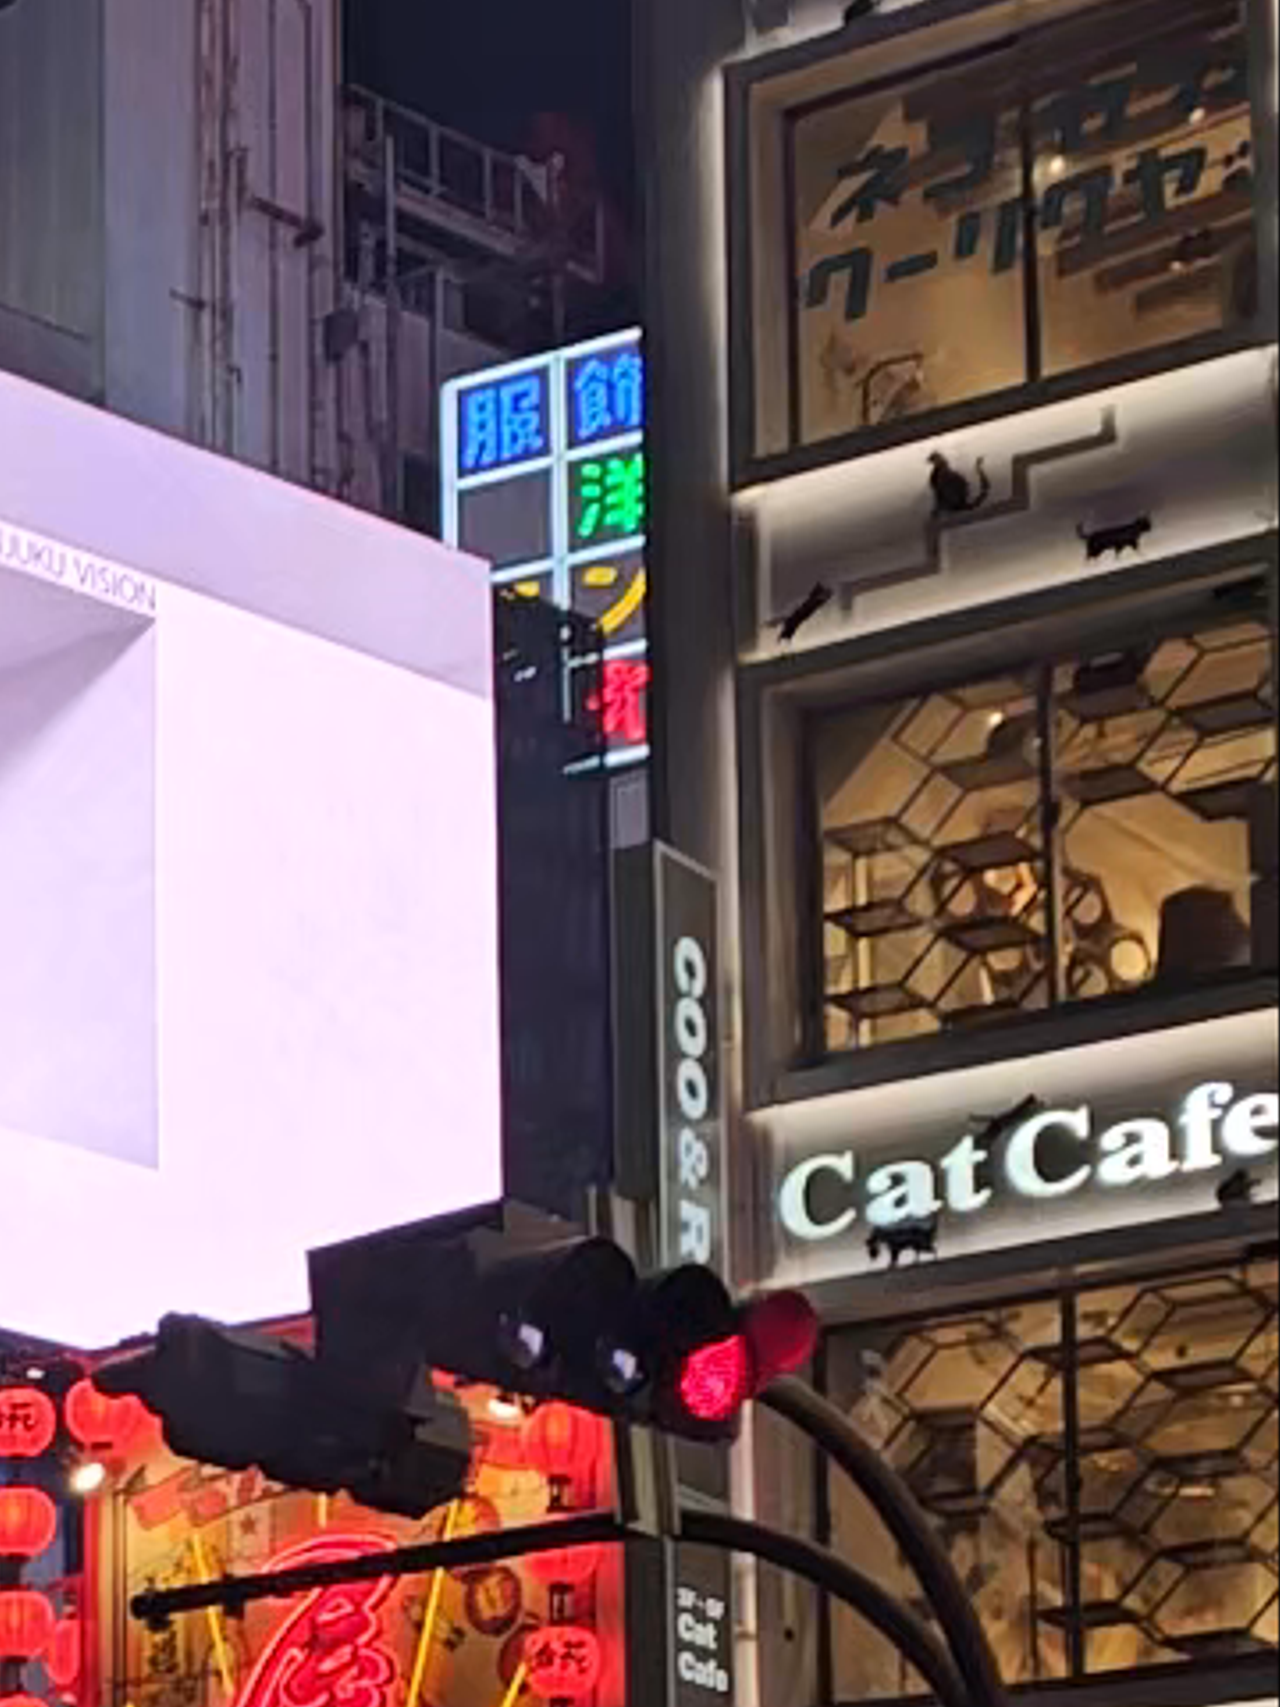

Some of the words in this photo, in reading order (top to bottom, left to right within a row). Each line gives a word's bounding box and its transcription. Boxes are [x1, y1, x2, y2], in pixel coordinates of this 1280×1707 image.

[72, 557, 158, 612] VISION
[778, 1135, 993, 1239] Cat
[1002, 1081, 1280, 1195] Cafe
[677, 1611, 718, 1650] Cat
[677, 1651, 729, 1693] Cafe
